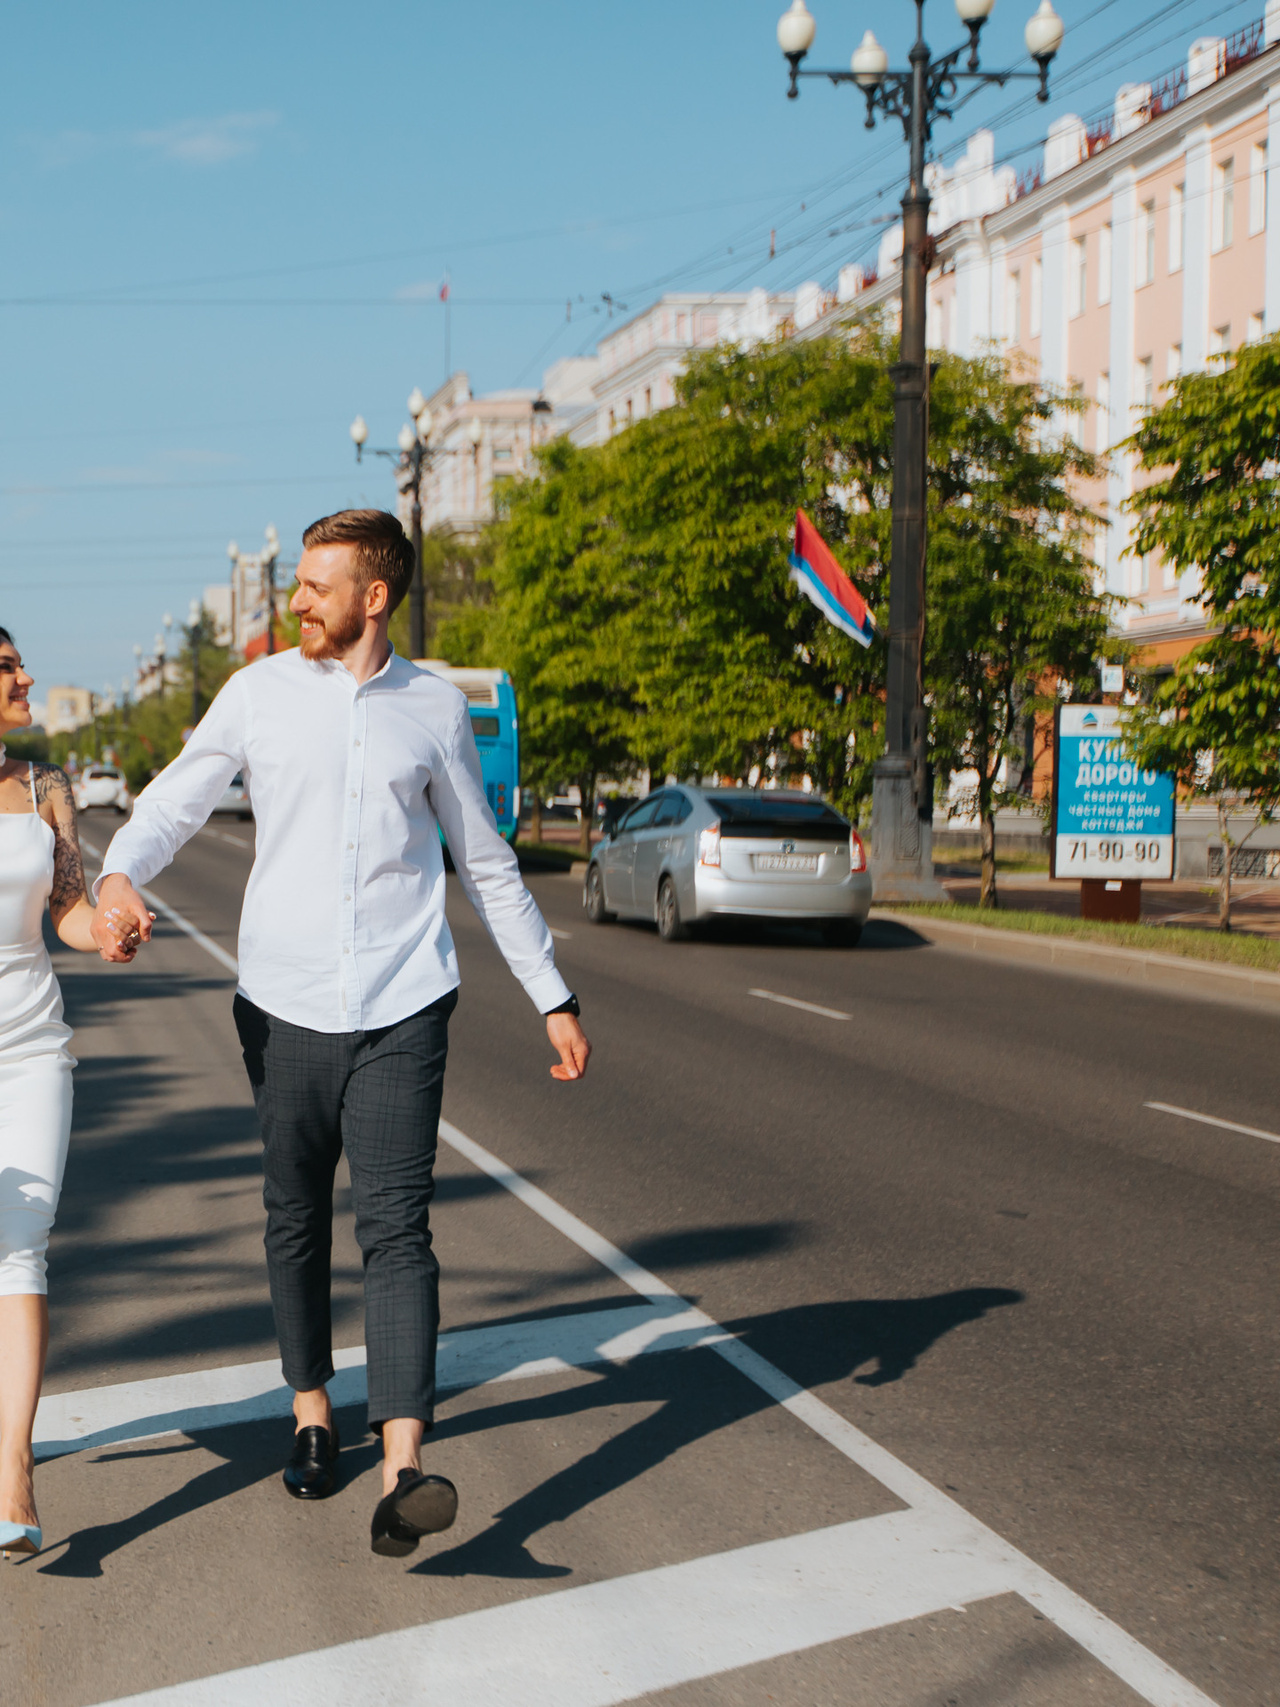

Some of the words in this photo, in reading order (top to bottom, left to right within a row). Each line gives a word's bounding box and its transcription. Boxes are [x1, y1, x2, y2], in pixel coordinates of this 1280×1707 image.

[1083, 790, 1147, 805] квартиры
[1068, 804, 1124, 817] частные
[1127, 804, 1161, 820] дома
[1081, 818, 1144, 833] коттеджи
[1068, 840, 1160, 862] 71-90-90
